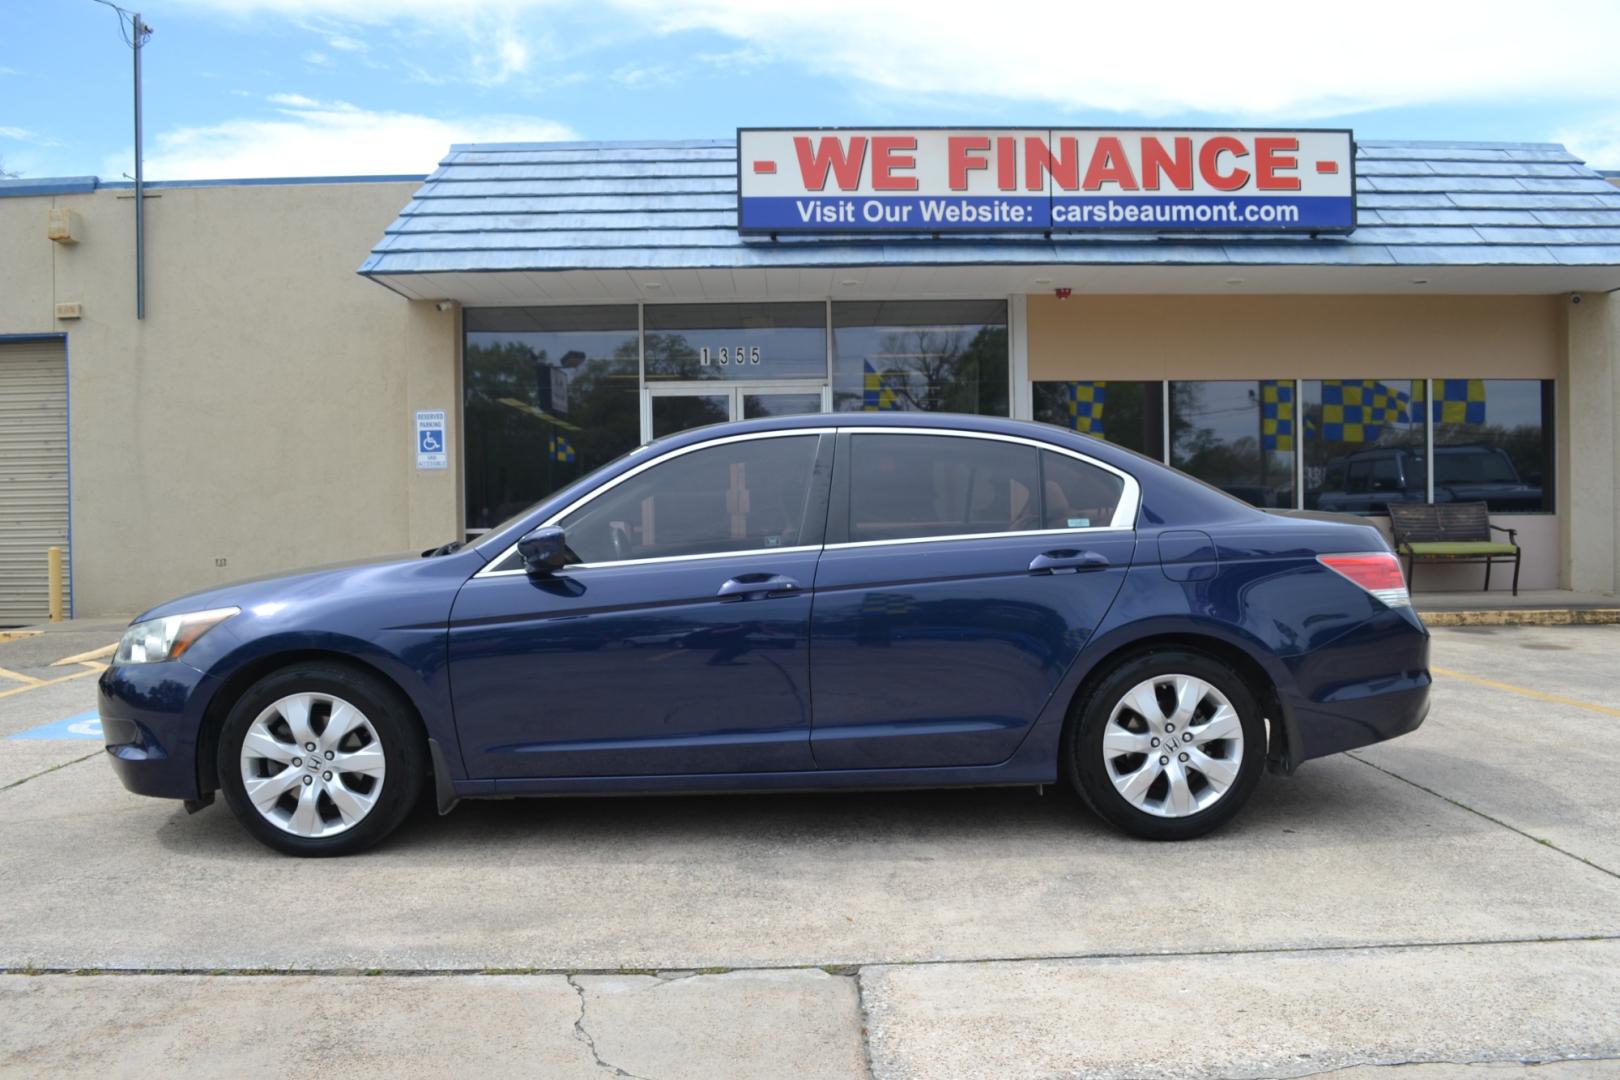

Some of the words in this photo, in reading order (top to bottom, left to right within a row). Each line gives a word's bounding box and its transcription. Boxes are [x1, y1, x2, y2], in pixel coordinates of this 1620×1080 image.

[793, 136, 919, 191] WE
[948, 136, 1301, 191] FINANCE
[796, 200, 855, 223] Visit
[863, 200, 912, 223] Our
[920, 200, 1032, 223] Website:
[1051, 200, 1299, 223] carsbeaumont.com
